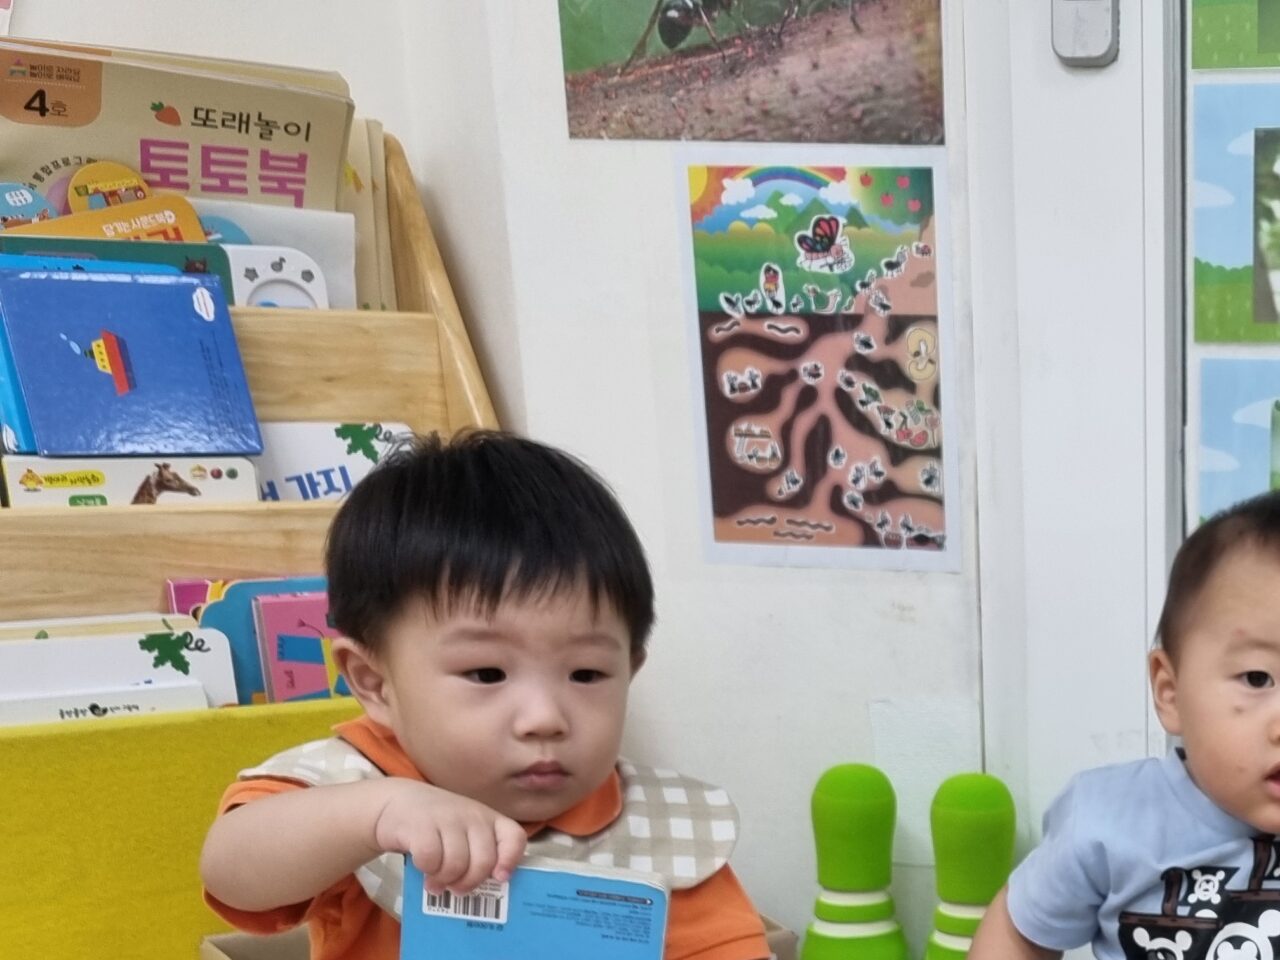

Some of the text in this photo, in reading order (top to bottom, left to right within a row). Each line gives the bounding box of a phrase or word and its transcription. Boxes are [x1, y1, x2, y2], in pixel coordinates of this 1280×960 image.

[24, 89, 69, 117] 4호
[191, 105, 312, 142] 또래놀이
[139, 138, 309, 209] 토토북
